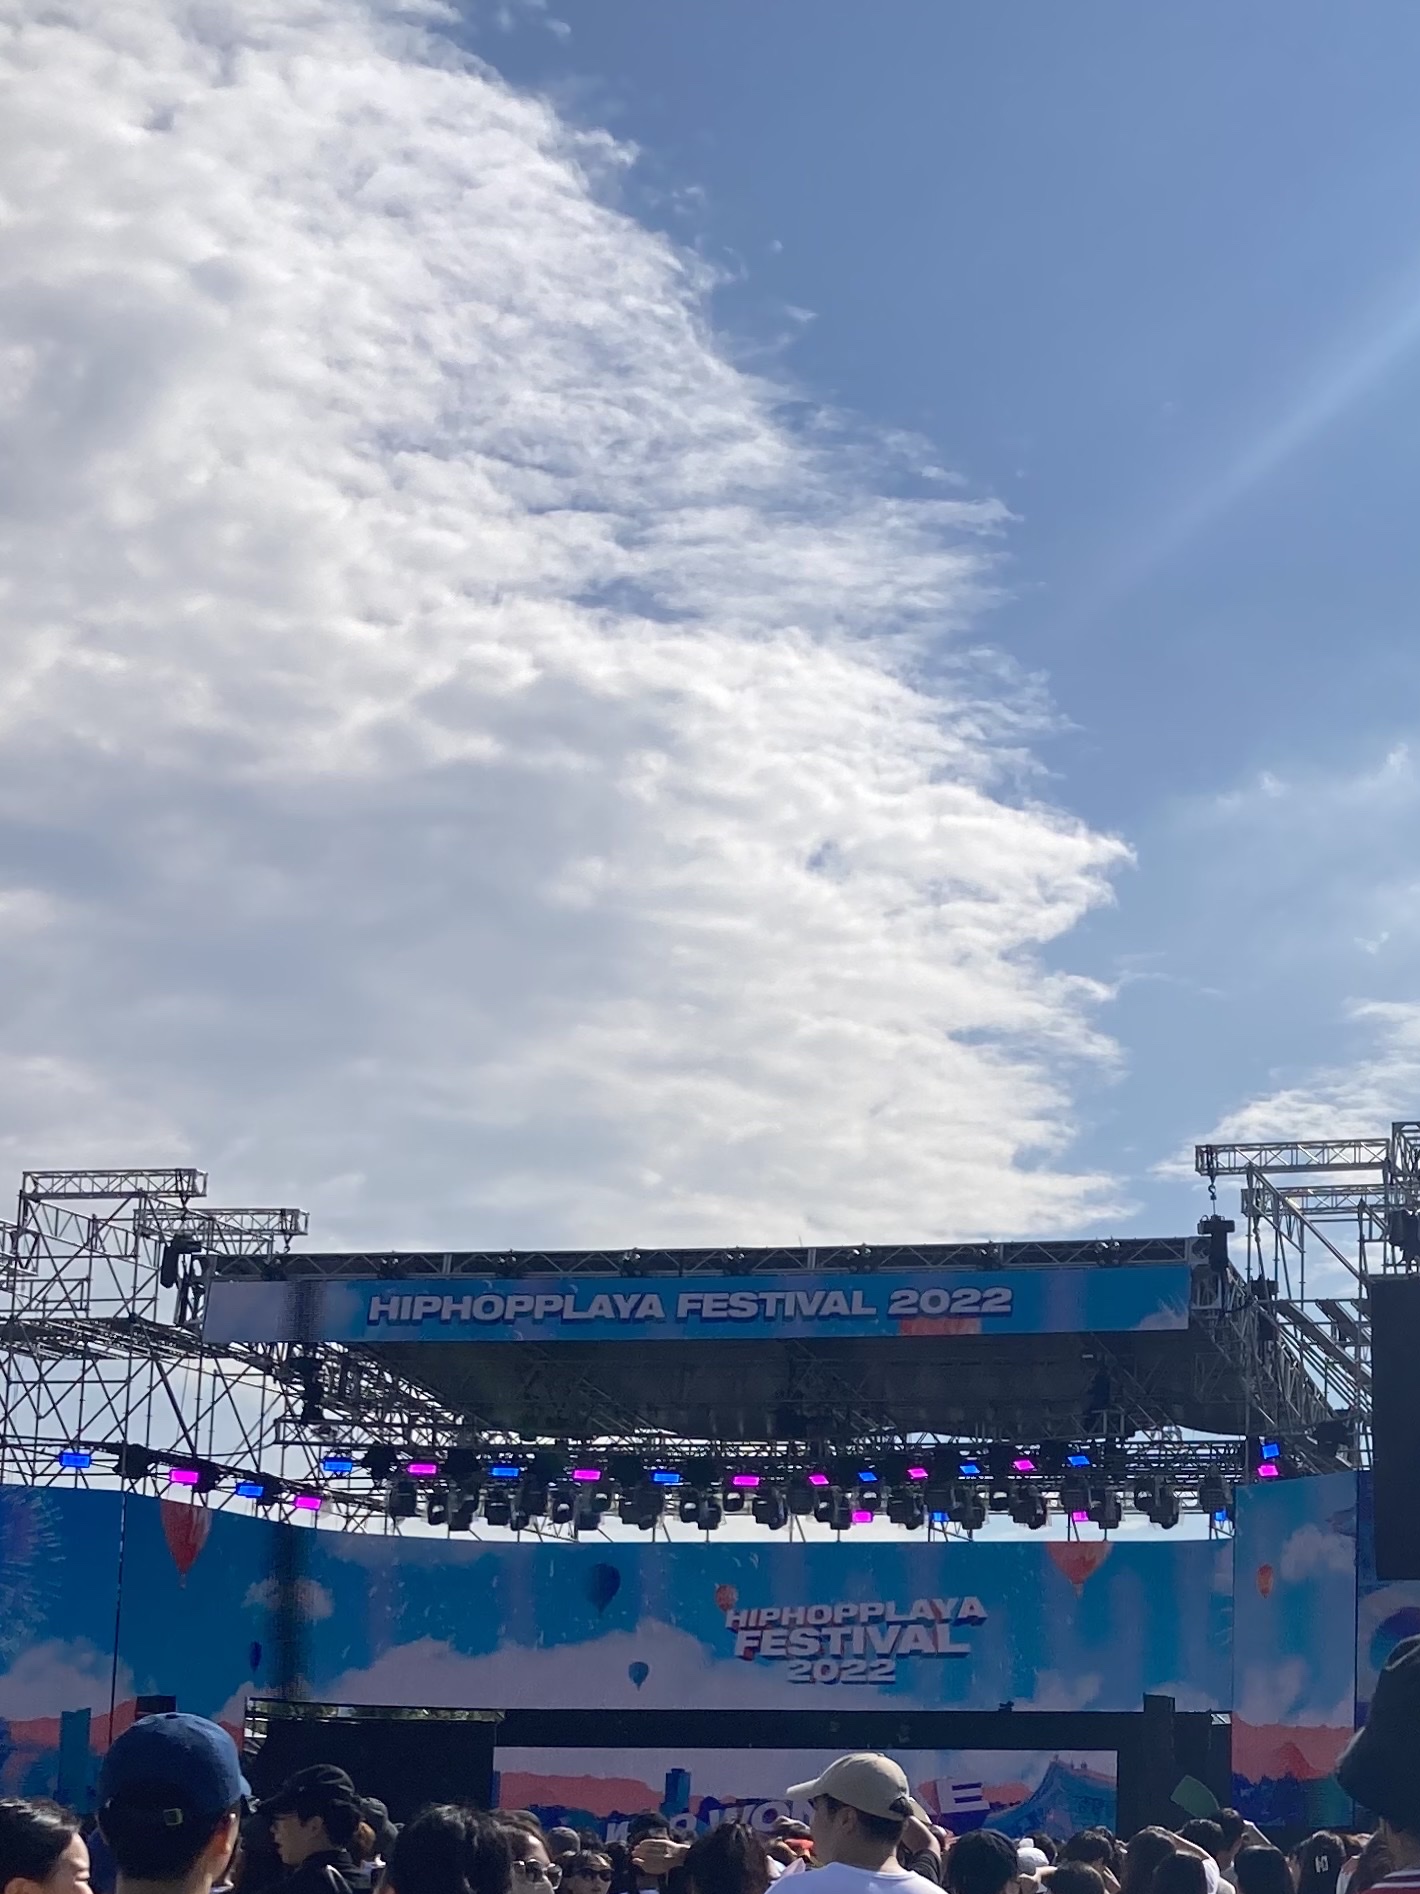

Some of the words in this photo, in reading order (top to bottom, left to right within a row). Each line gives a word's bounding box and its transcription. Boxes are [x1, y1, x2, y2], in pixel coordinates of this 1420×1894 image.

[367, 1293, 666, 1323] HIPHOPPLAYA
[675, 1290, 877, 1320] FESTIVAL
[887, 1286, 1013, 1317] 2022
[724, 1596, 988, 1632] HIPHOPPLAYA
[734, 1622, 972, 1659] FESTIVAL
[786, 1659, 897, 1684] 2022
